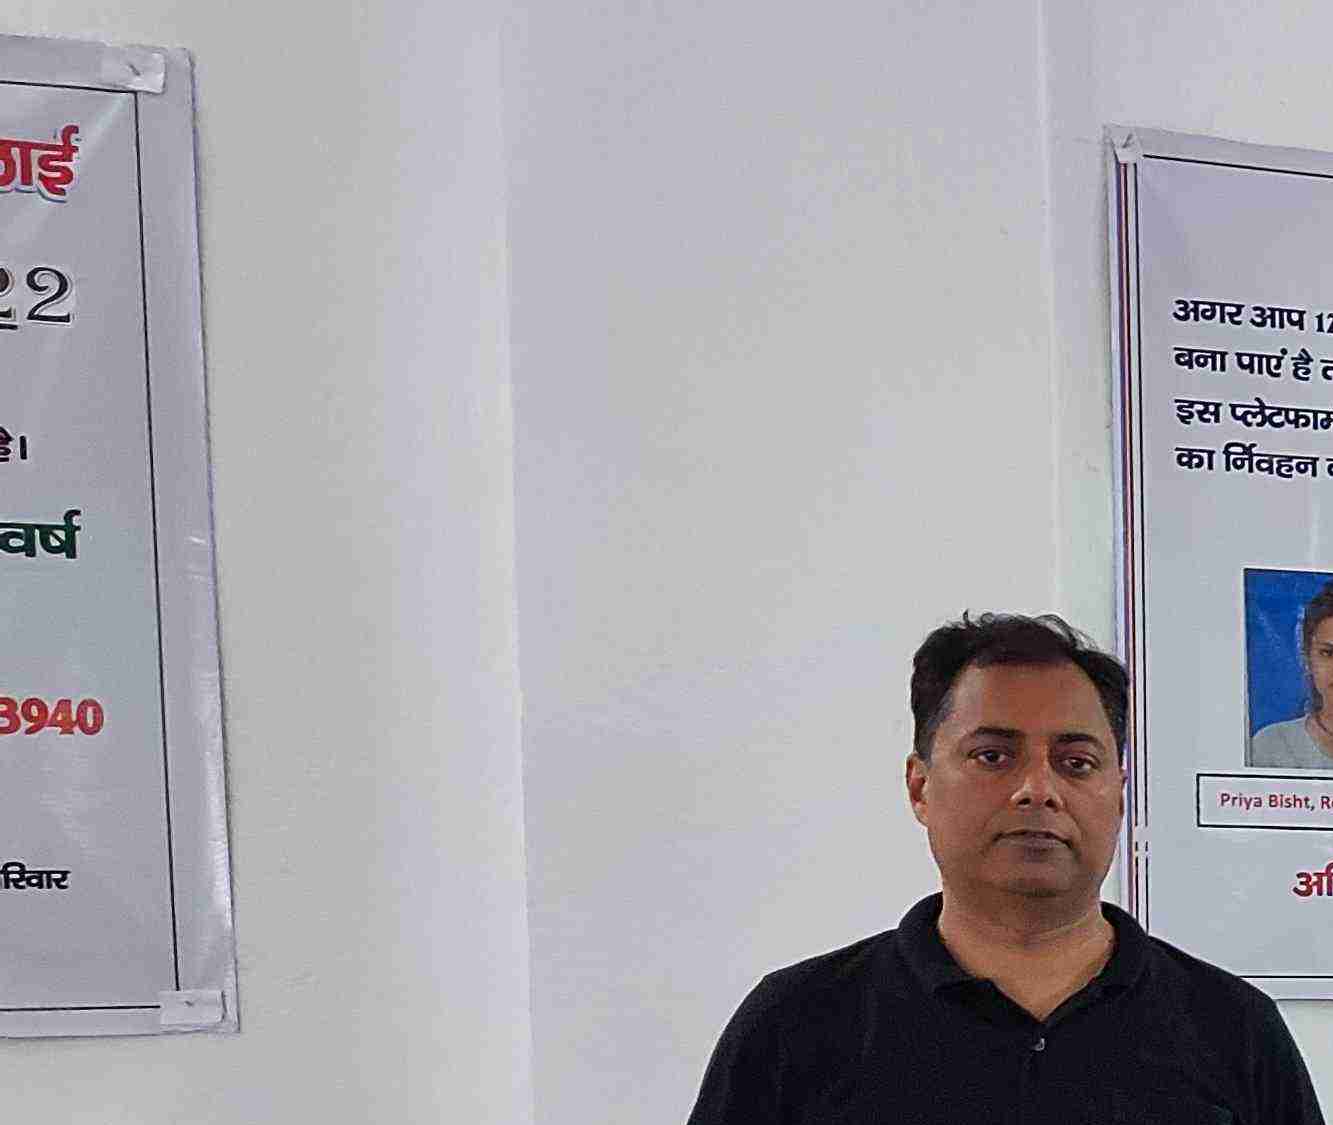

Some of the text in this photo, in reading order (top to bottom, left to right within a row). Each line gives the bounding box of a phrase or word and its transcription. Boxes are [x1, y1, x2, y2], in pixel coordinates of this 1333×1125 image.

[1173, 300, 1245, 325] अगर
[1250, 306, 1306, 330] आप
[1174, 347, 1228, 372] बना
[1235, 348, 1288, 377] पाएं
[1291, 348, 1313, 381] है
[1174, 399, 1222, 425] इस
[1175, 447, 1215, 470] का
[1221, 793, 1262, 810] Priya
[1269, 794, 1315, 811] Bisht,
[0, 861, 71, 890] रिवार
